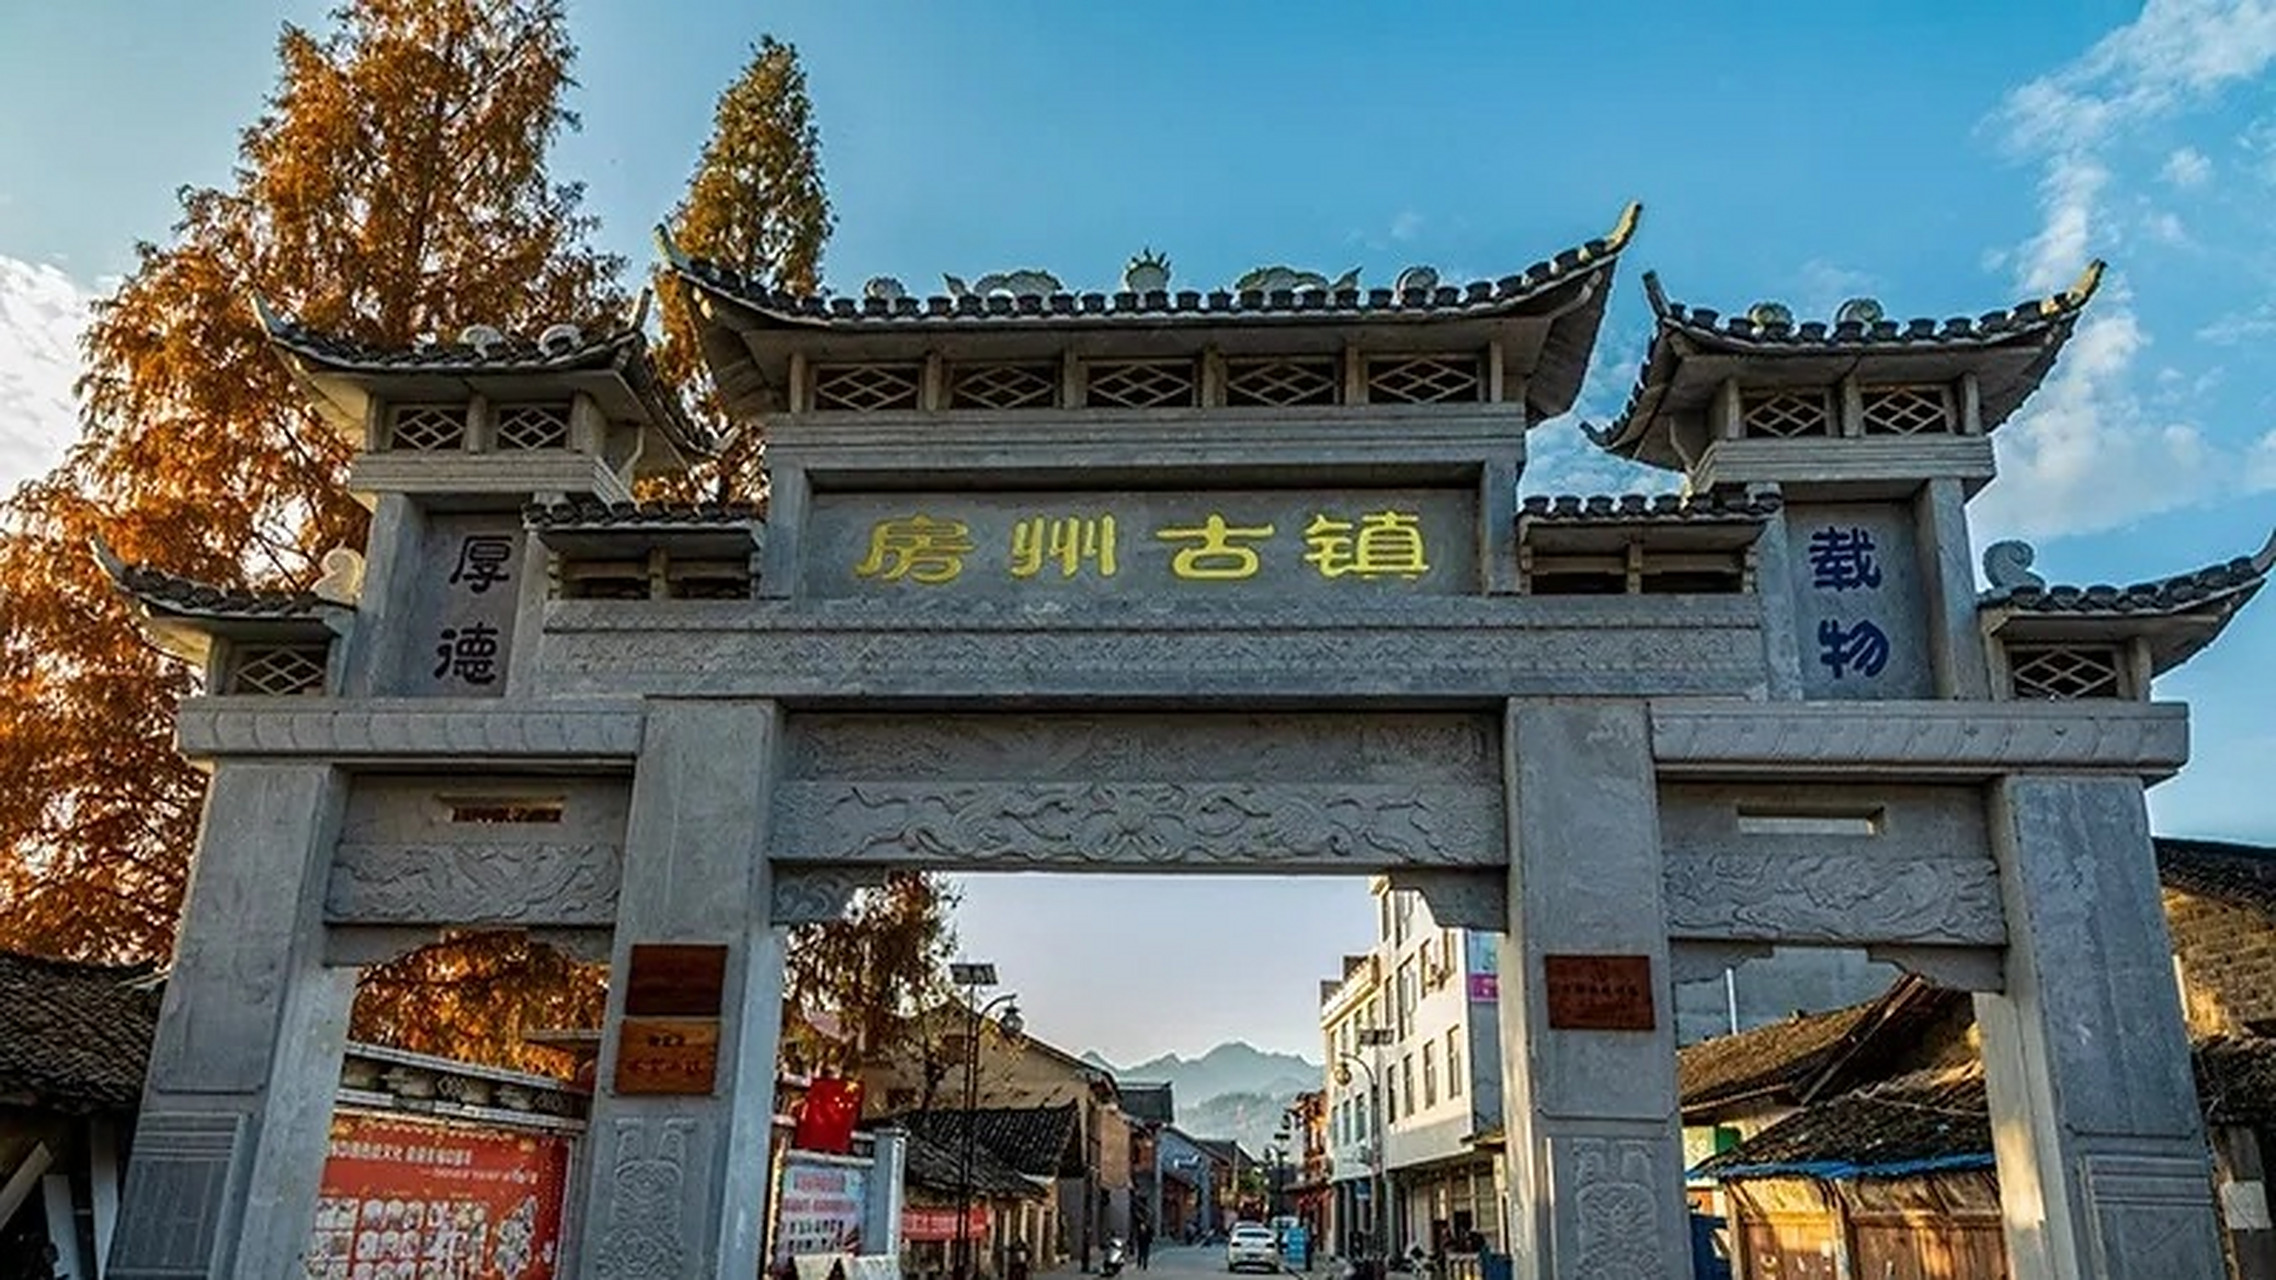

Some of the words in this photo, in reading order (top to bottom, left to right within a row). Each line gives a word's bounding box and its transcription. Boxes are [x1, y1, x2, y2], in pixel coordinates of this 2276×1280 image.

[434, 535, 513, 685] 厚德
[854, 512, 1429, 583] 房州古镇
[1808, 525, 1890, 679] 载物
